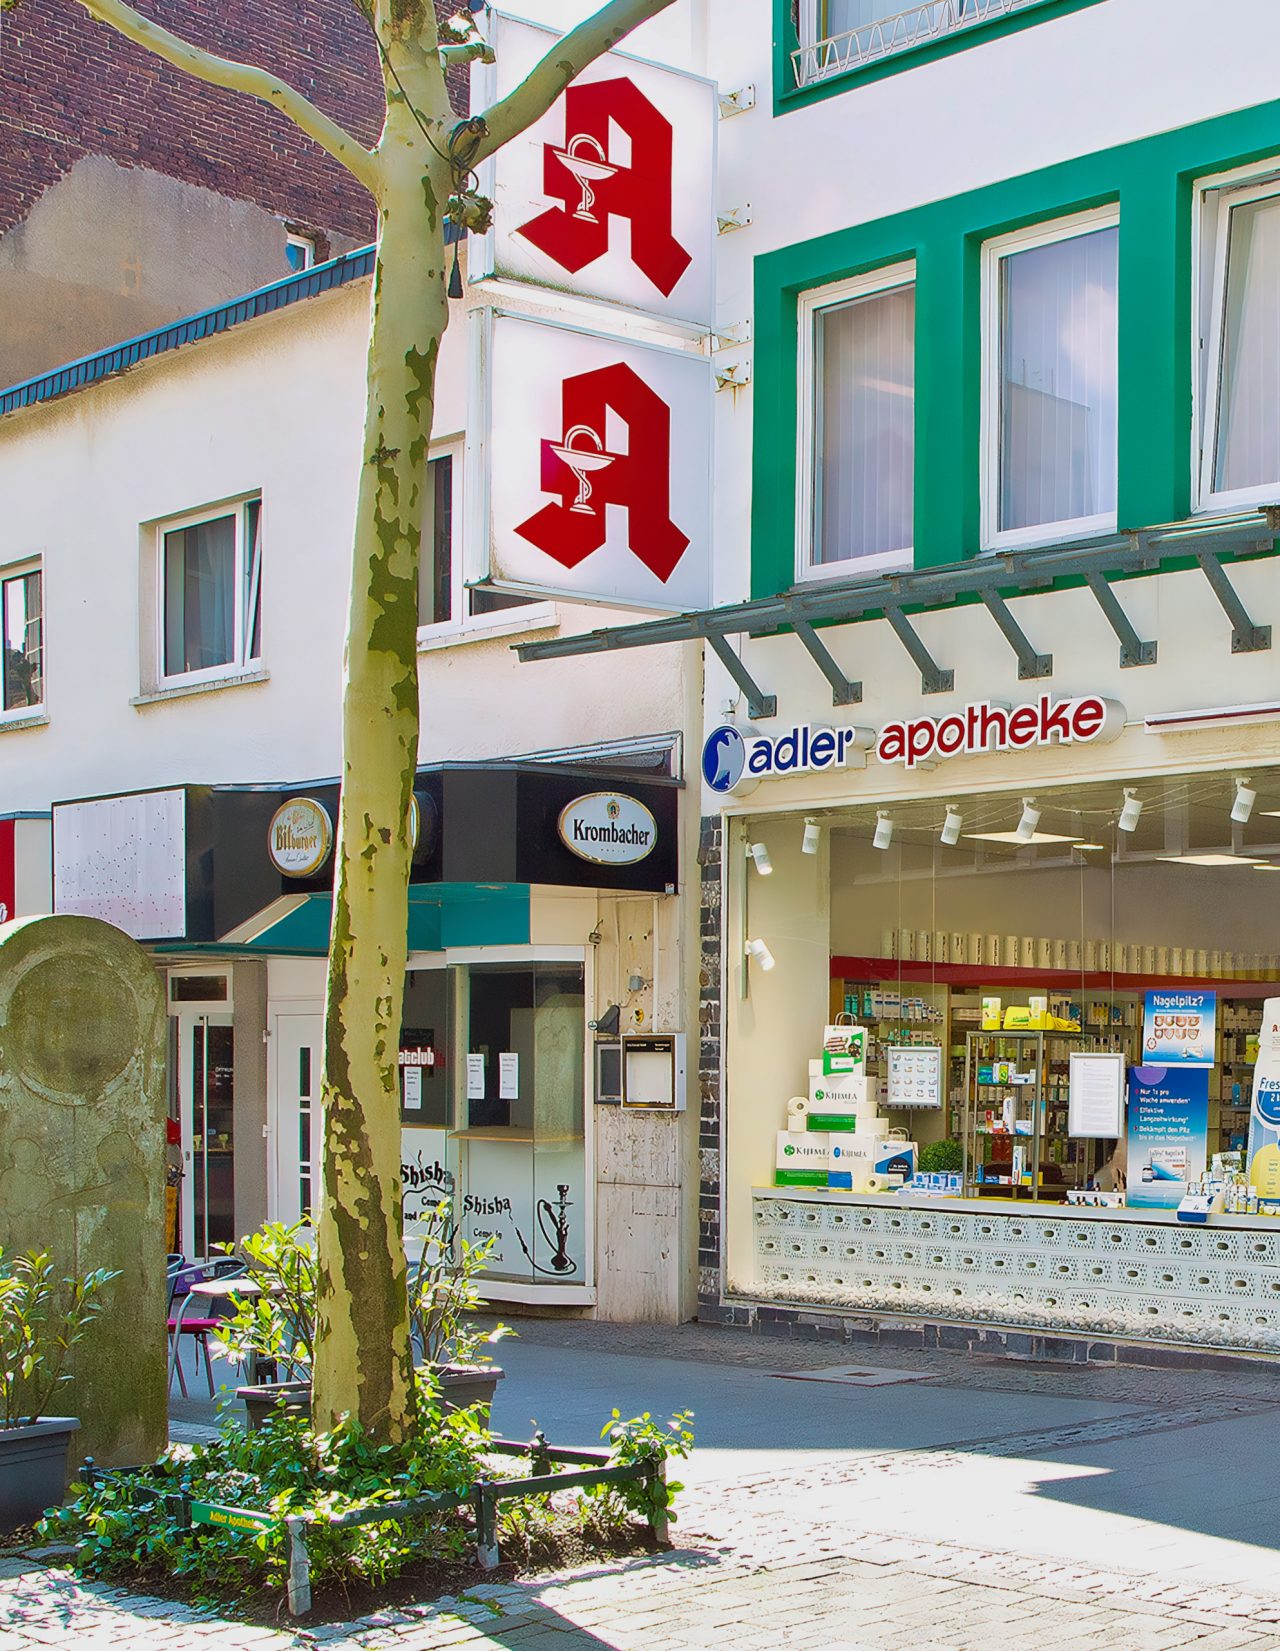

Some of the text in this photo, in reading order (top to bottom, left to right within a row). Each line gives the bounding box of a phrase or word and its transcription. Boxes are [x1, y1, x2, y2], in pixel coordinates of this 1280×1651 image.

[748, 696, 1104, 774] adler apotheke
[275, 824, 318, 851] Bitburger
[573, 818, 650, 846] Krombacher
[1153, 995, 1204, 1009] Nagelpilz?
[463, 1194, 512, 1216] Shisha
